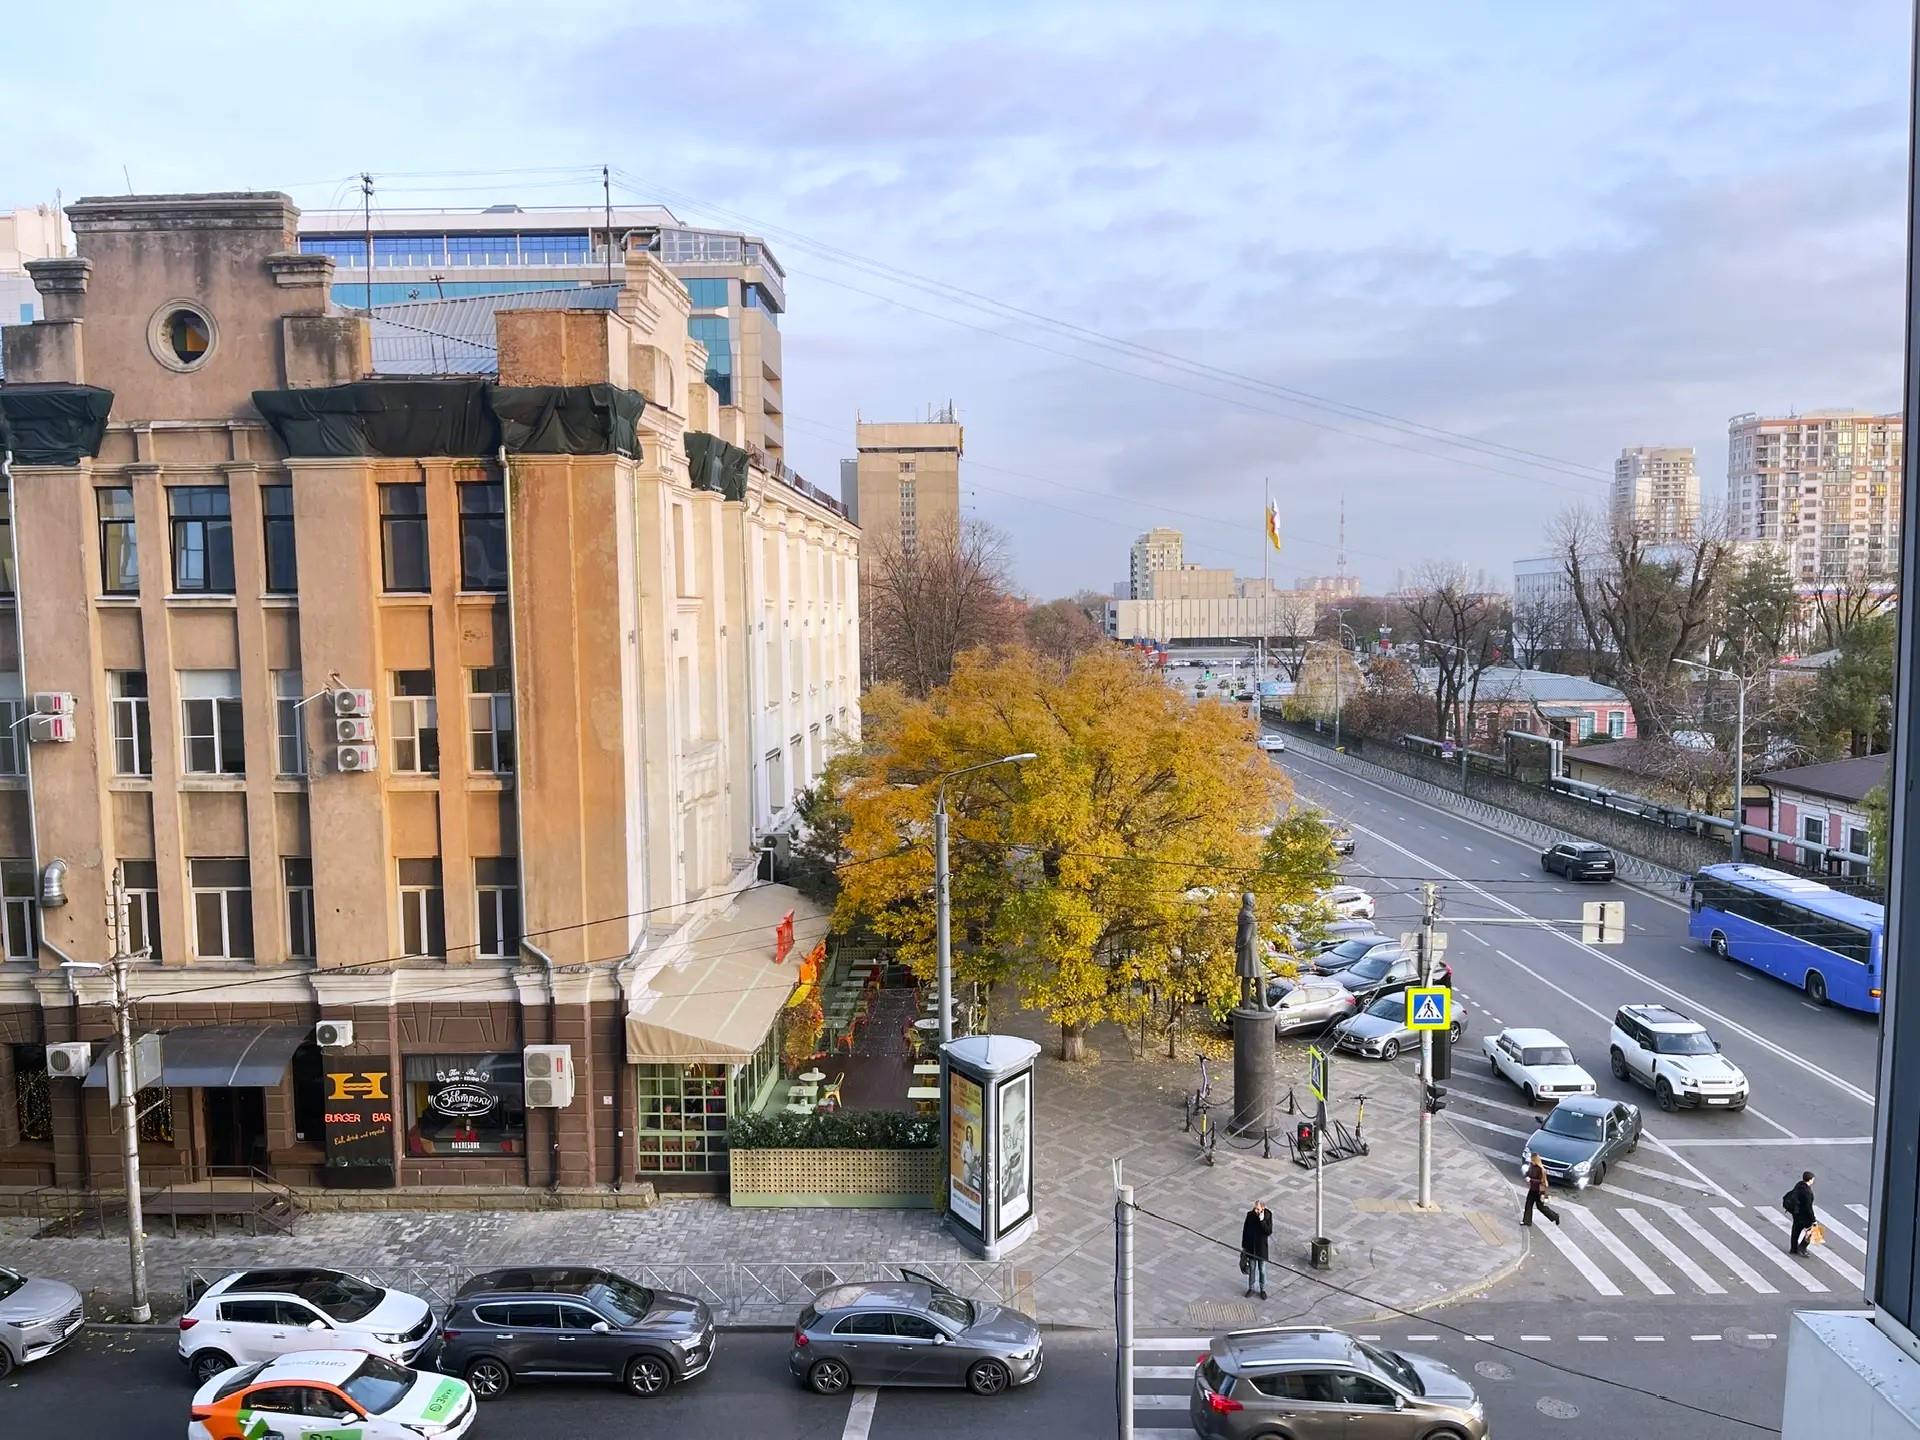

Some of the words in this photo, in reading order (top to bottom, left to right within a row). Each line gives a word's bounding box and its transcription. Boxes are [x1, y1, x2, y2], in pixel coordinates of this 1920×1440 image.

[440, 1090, 491, 1108] Завтраки
[324, 1113, 361, 1122] BURGER
[372, 1112, 392, 1122] BAR
